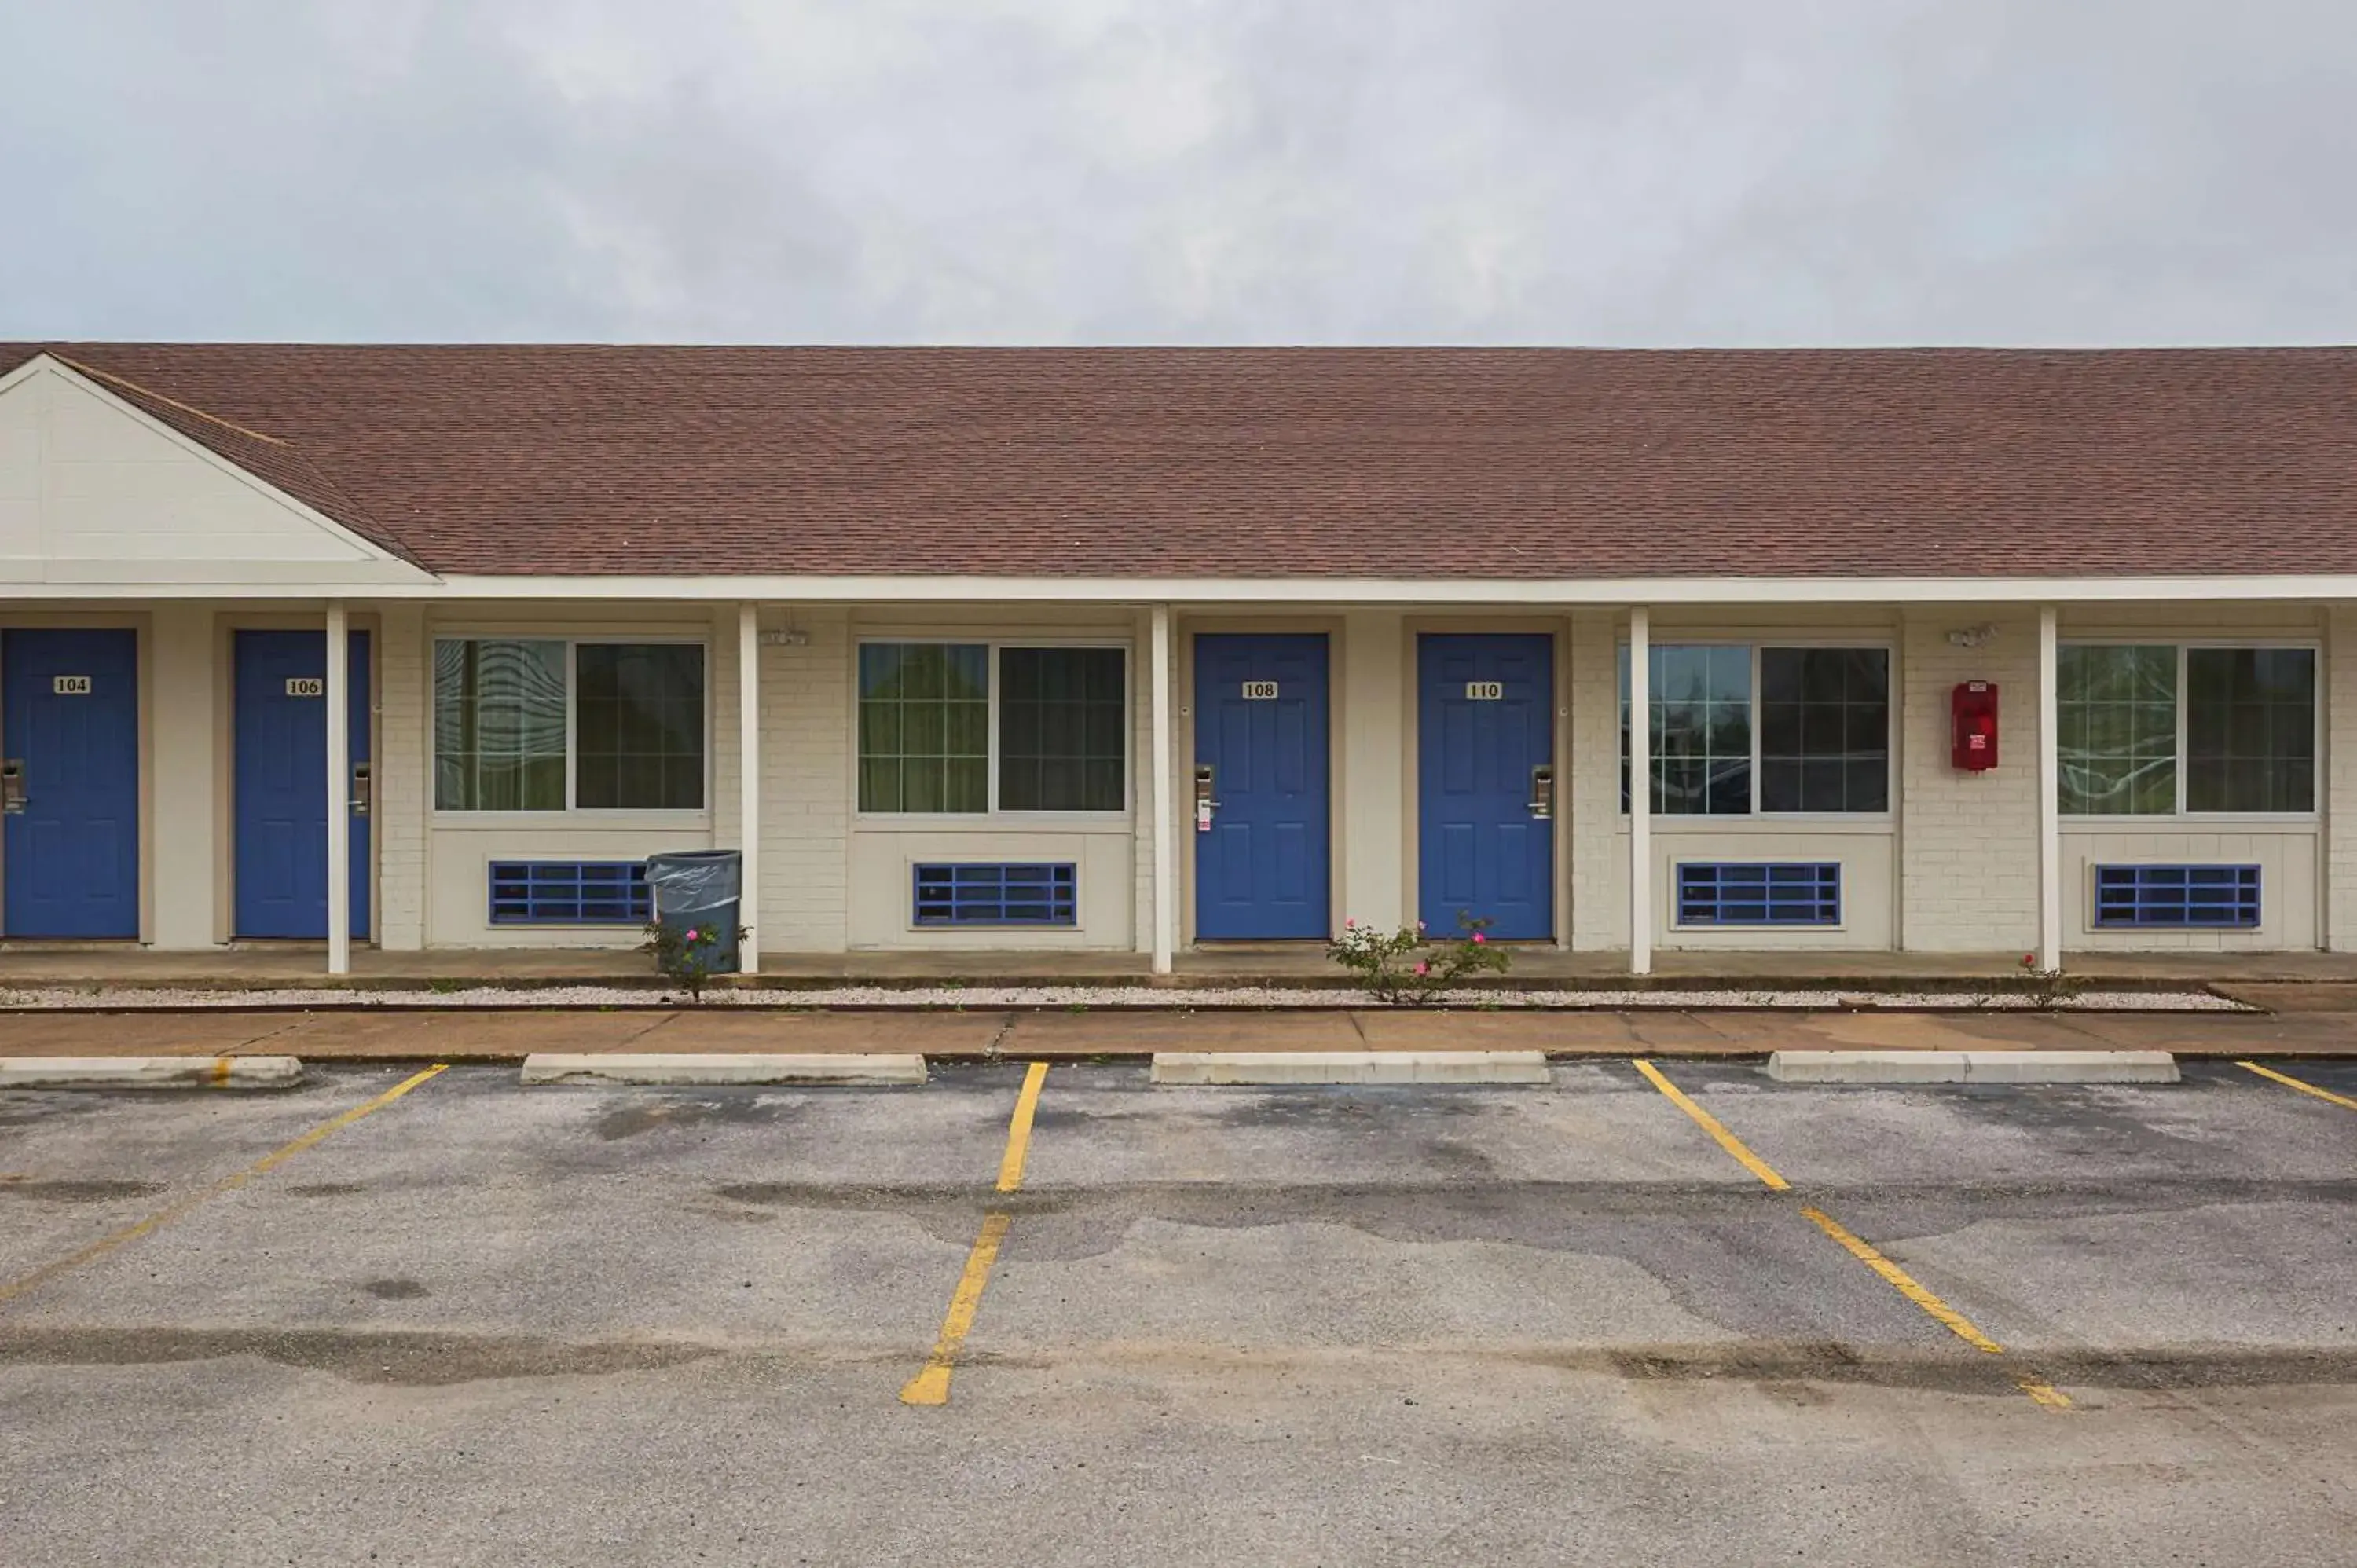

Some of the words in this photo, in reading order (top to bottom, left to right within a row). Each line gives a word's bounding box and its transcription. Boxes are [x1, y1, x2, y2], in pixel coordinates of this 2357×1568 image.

[58, 678, 86, 692] 104
[291, 680, 319, 694] 106
[1247, 683, 1274, 698] 108
[1471, 684, 1499, 698] 110
